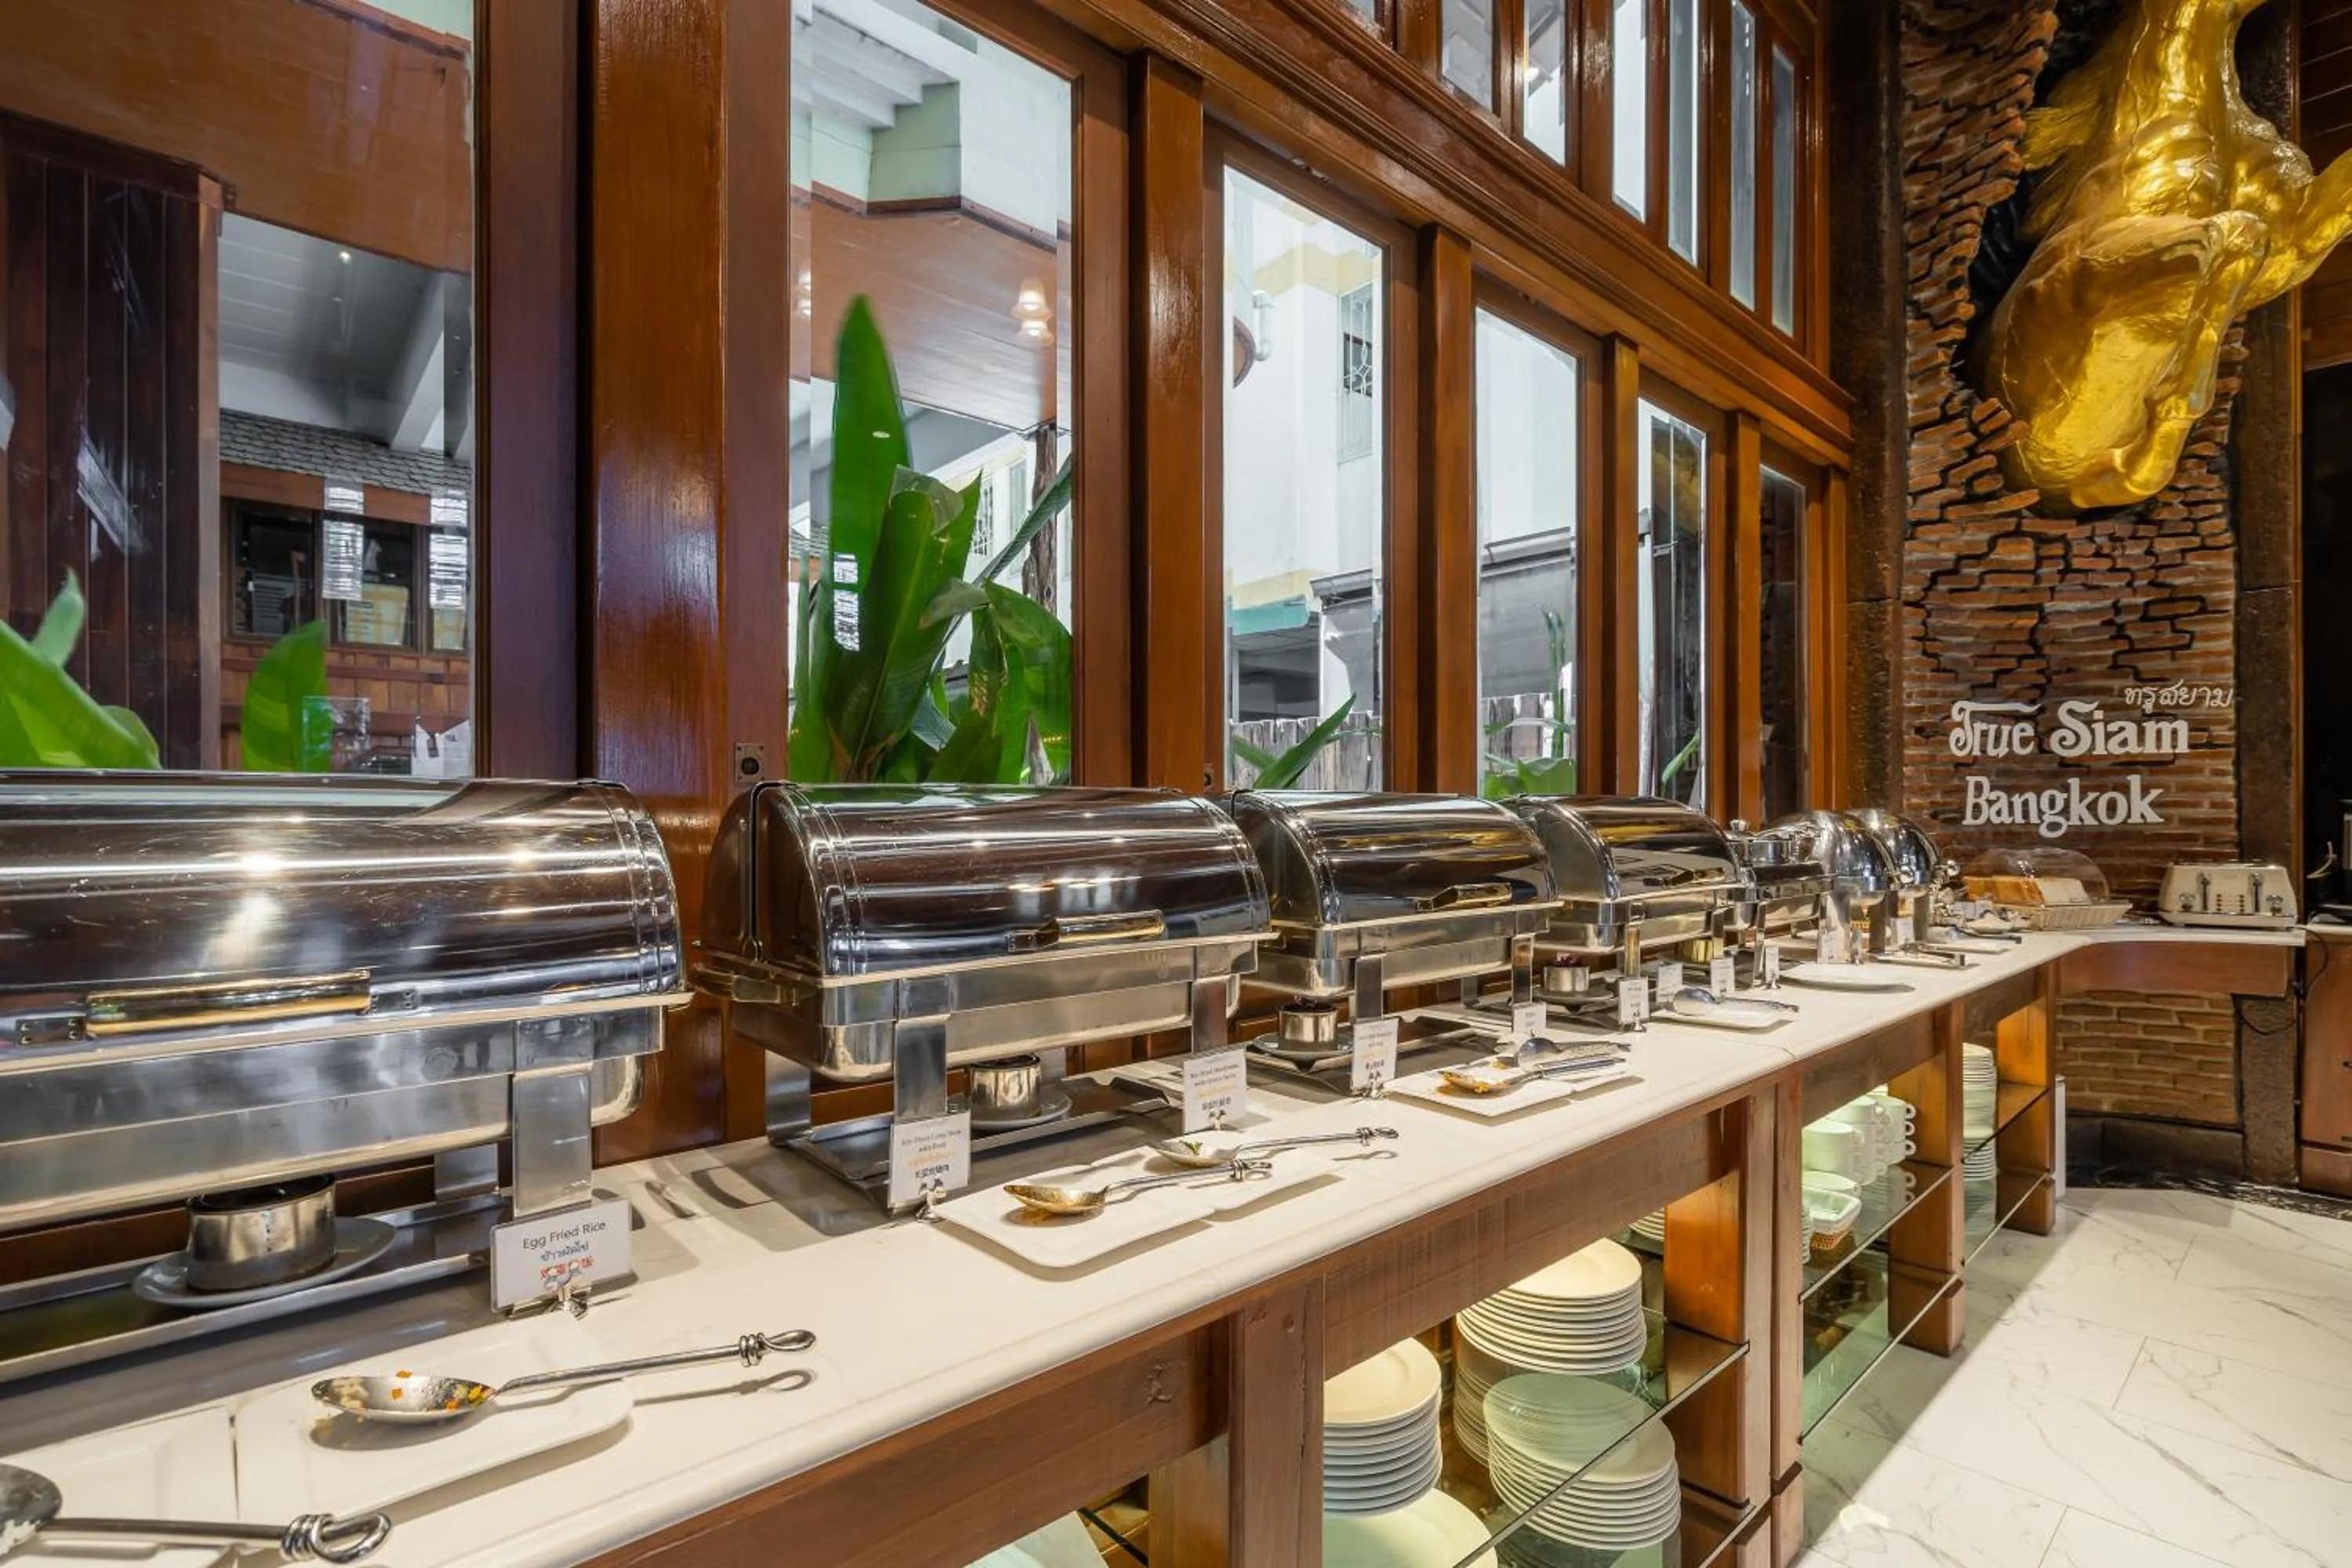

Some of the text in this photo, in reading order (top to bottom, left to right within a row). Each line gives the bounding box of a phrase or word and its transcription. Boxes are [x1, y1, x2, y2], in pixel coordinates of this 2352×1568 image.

[2124, 678, 2234, 714] ทรูสยาม
[1948, 700, 2190, 758] True Siam
[1962, 774, 2165, 839] Bangkok
[522, 1221, 606, 1250] Egg Fried Rice
